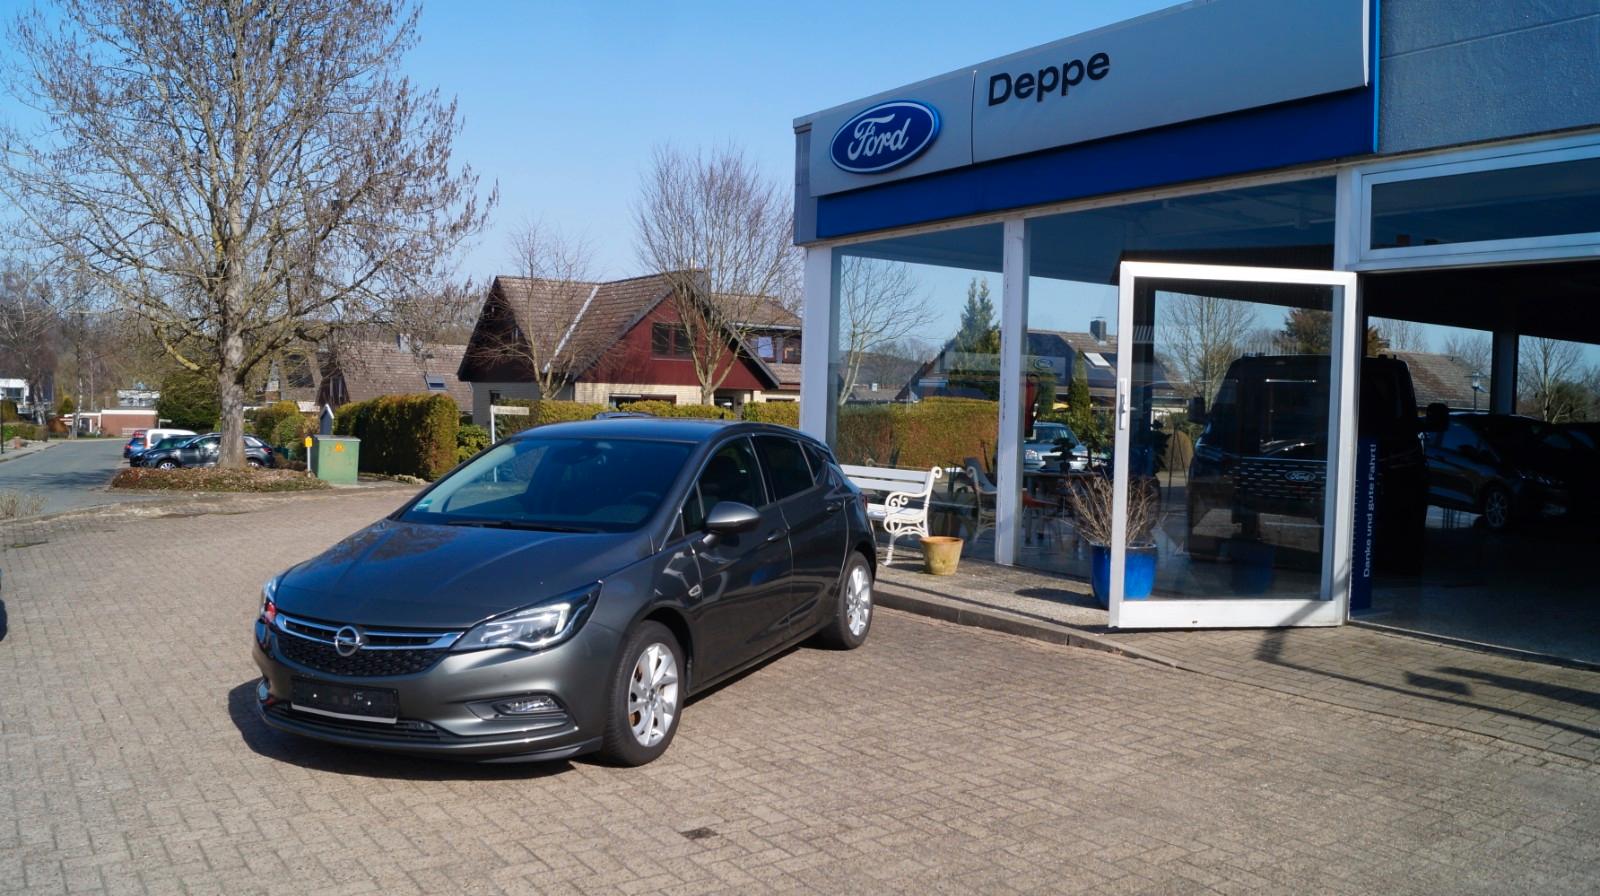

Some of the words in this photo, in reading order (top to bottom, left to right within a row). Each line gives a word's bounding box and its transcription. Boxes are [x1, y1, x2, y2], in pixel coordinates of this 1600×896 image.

[988, 52, 1110, 106] Deppe
[847, 113, 911, 161] Ford
[1363, 539, 1372, 577] Danke
[1368, 444, 1377, 480] Fahrt!
